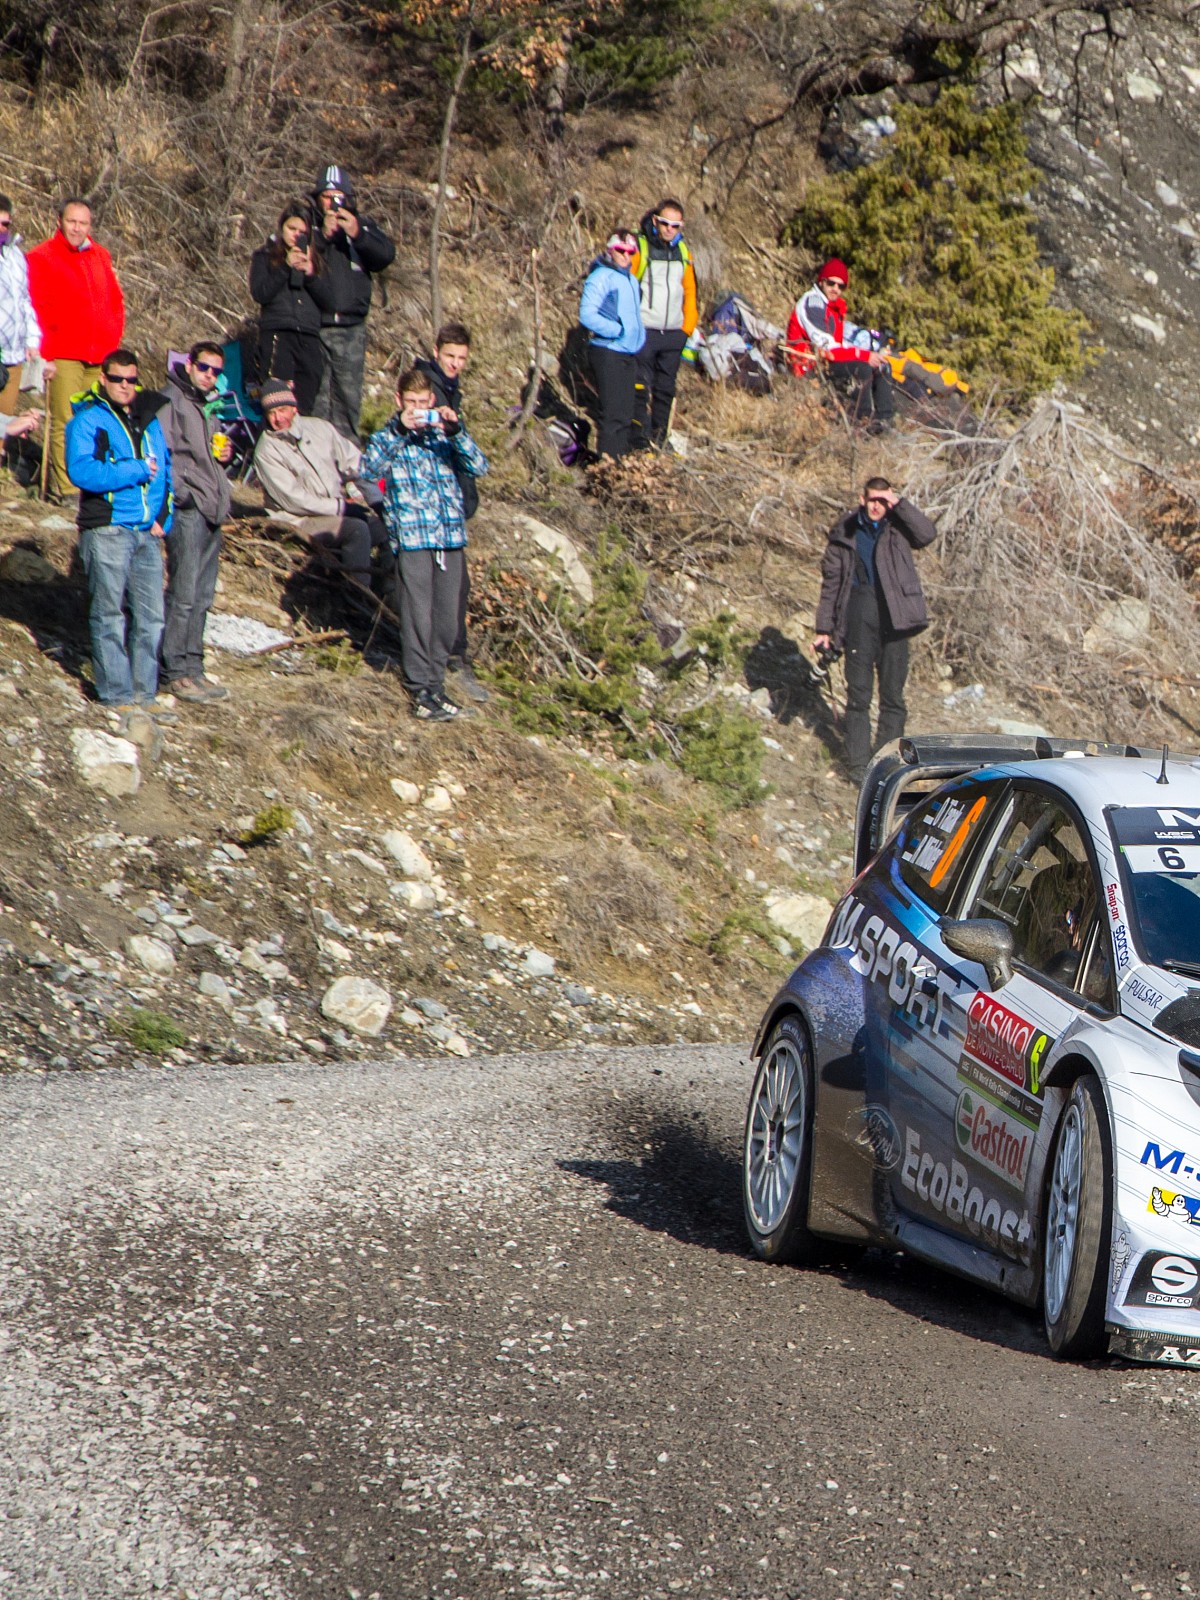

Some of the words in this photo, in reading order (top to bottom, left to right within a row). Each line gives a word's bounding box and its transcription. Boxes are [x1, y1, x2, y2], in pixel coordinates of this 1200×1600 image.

[930, 796, 987, 888] 6
[1157, 846, 1186, 870] 6
[1107, 883, 1120, 921] Snap-on
[829, 895, 959, 1036] M-SPORT
[1115, 924, 1130, 967] sparco
[1127, 979, 1163, 1009] PULSAR
[966, 1032, 976, 1049] DE
[976, 1039, 1024, 1081] MONTE-CARLO
[968, 997, 1029, 1061] CASINO
[1030, 1034, 1047, 1095] 6
[971, 1105, 1028, 1181] Castrol
[902, 1126, 1032, 1267] EcoBoost
[1147, 1294, 1192, 1306] sparco
